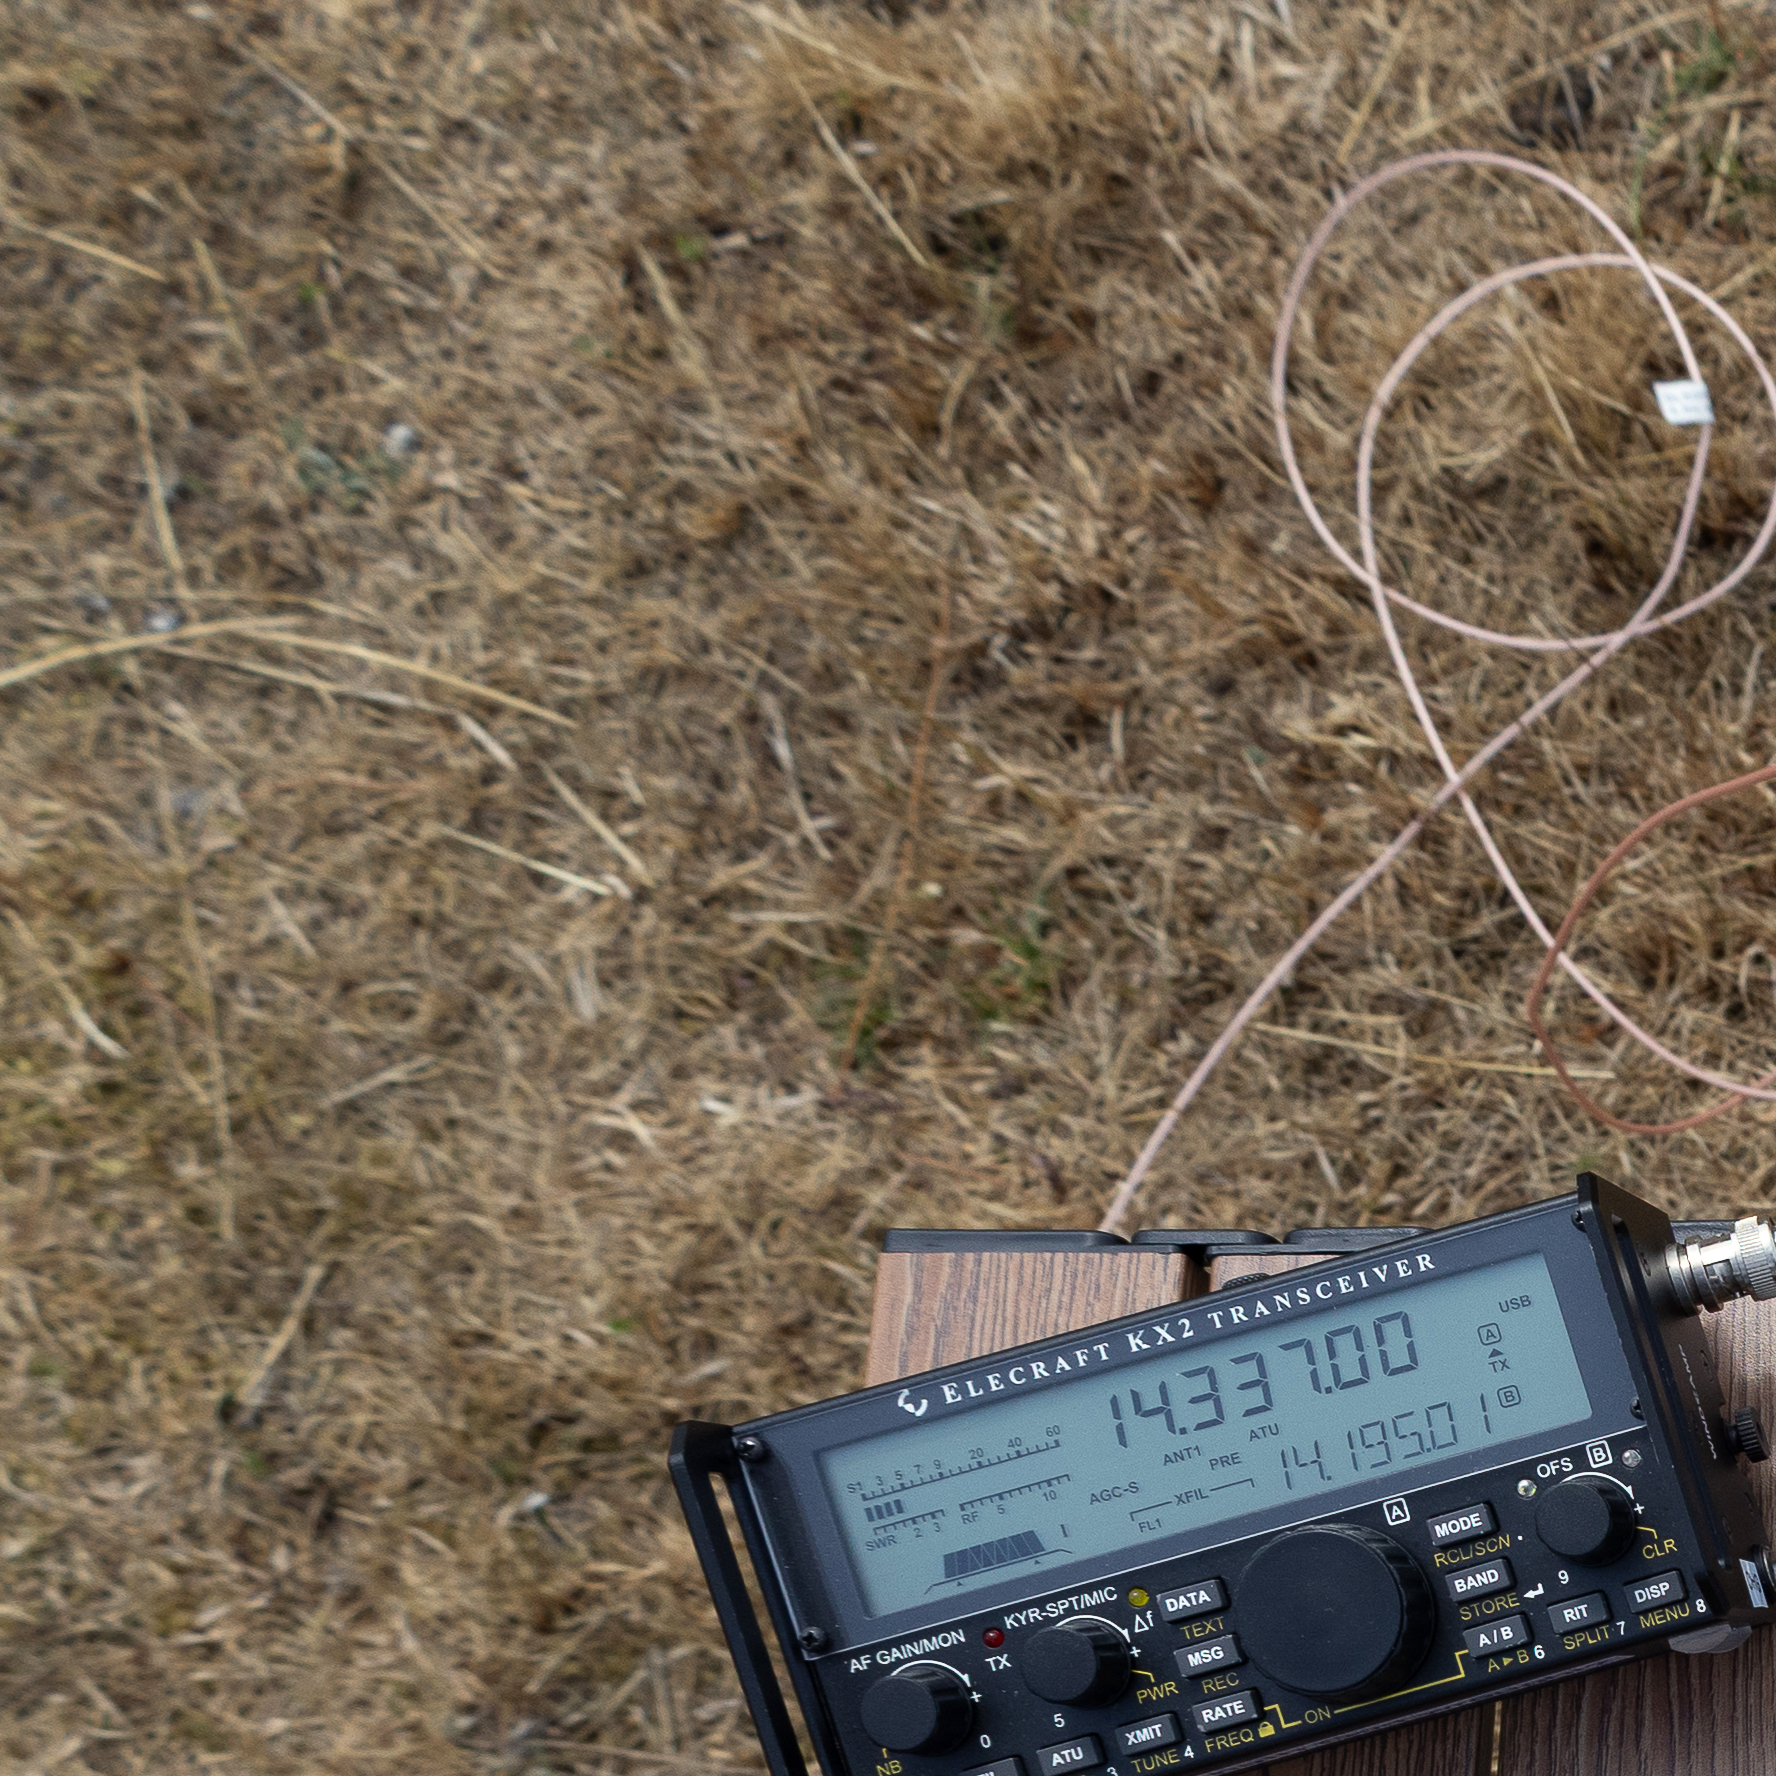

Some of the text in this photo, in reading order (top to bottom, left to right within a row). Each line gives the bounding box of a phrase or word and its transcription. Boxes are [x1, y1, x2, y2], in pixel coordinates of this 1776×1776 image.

[1499, 1294, 1532, 1314] USB
[942, 1252, 1437, 1406] ELECRAFT KX2 TRANSCEIVER
[1488, 1358, 1511, 1373] TX
[1249, 1422, 1280, 1442] ATU
[875, 1475, 884, 1487] 3
[895, 1469, 904, 1482] 5
[913, 1464, 922, 1476] 7
[933, 1458, 942, 1471] 9
[968, 1446, 985, 1460] 20
[1007, 1435, 1023, 1449] 40
[1045, 1424, 1062, 1438] 60
[1162, 1445, 1203, 1466] ANT1
[1208, 1451, 1242, 1471] PRE
[1536, 1456, 1574, 1479] OFS
[1089, 1480, 1140, 1505] AGC-S
[1173, 1487, 1209, 1507] XFIL
[961, 1489, 1058, 1525] RF 5 10
[865, 1522, 942, 1552] SWR 2 3
[1137, 1517, 1163, 1534] FL1
[1434, 1512, 1483, 1539] MODE
[1433, 1533, 1512, 1568] RCL/SCN
[1641, 1538, 1678, 1560] CLR
[1454, 1568, 1500, 1593] BAND
[1557, 1569, 1570, 1585] 9
[1165, 1589, 1212, 1613] DATA
[1634, 1581, 1671, 1604] DISP
[1004, 1585, 1118, 1630] KYR-SPT/MIC
[1459, 1592, 1521, 1621] STORE
[1562, 1603, 1589, 1623] RIT
[1639, 1598, 1707, 1630] MENU 8
[1179, 1615, 1226, 1641] TEXT
[1562, 1620, 1627, 1652] SPLIT 7
[849, 1628, 967, 1674] AF GAIN/MON
[984, 1653, 1013, 1673] TX
[1187, 1646, 1225, 1668] MSG
[1533, 1644, 1546, 1660] 6
[1135, 1680, 1180, 1705] PWR
[1201, 1671, 1241, 1695] REC
[1053, 1712, 1066, 1729] 5
[1201, 1699, 1247, 1724] RATE
[1304, 1704, 1332, 1725] ON
[979, 1733, 992, 1749] 0
[1125, 1723, 1164, 1747] XMIT
[1204, 1727, 1255, 1753] FREQ
[1051, 1746, 1085, 1768] ATU
[1130, 1744, 1196, 1775] TUNE 4
